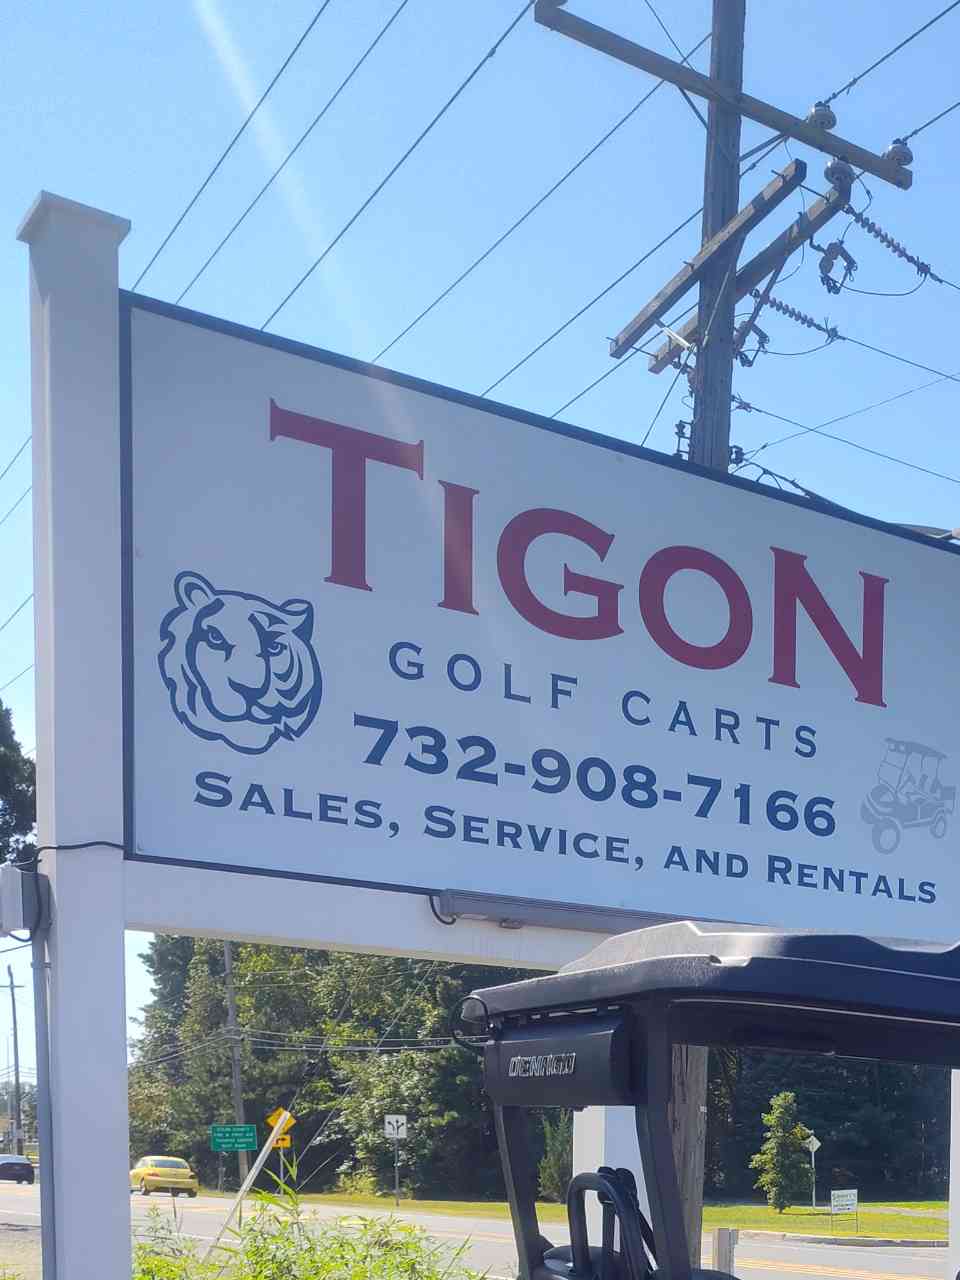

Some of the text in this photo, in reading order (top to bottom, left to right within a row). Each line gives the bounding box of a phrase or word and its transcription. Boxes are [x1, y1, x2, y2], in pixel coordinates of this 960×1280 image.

[269, 397, 890, 709] TIGON
[388, 641, 818, 759] GOLF CARTS
[193, 770, 938, 905] SALES, SERVICE, AND RENTALS
[353, 711, 837, 838] 732-908-7166
